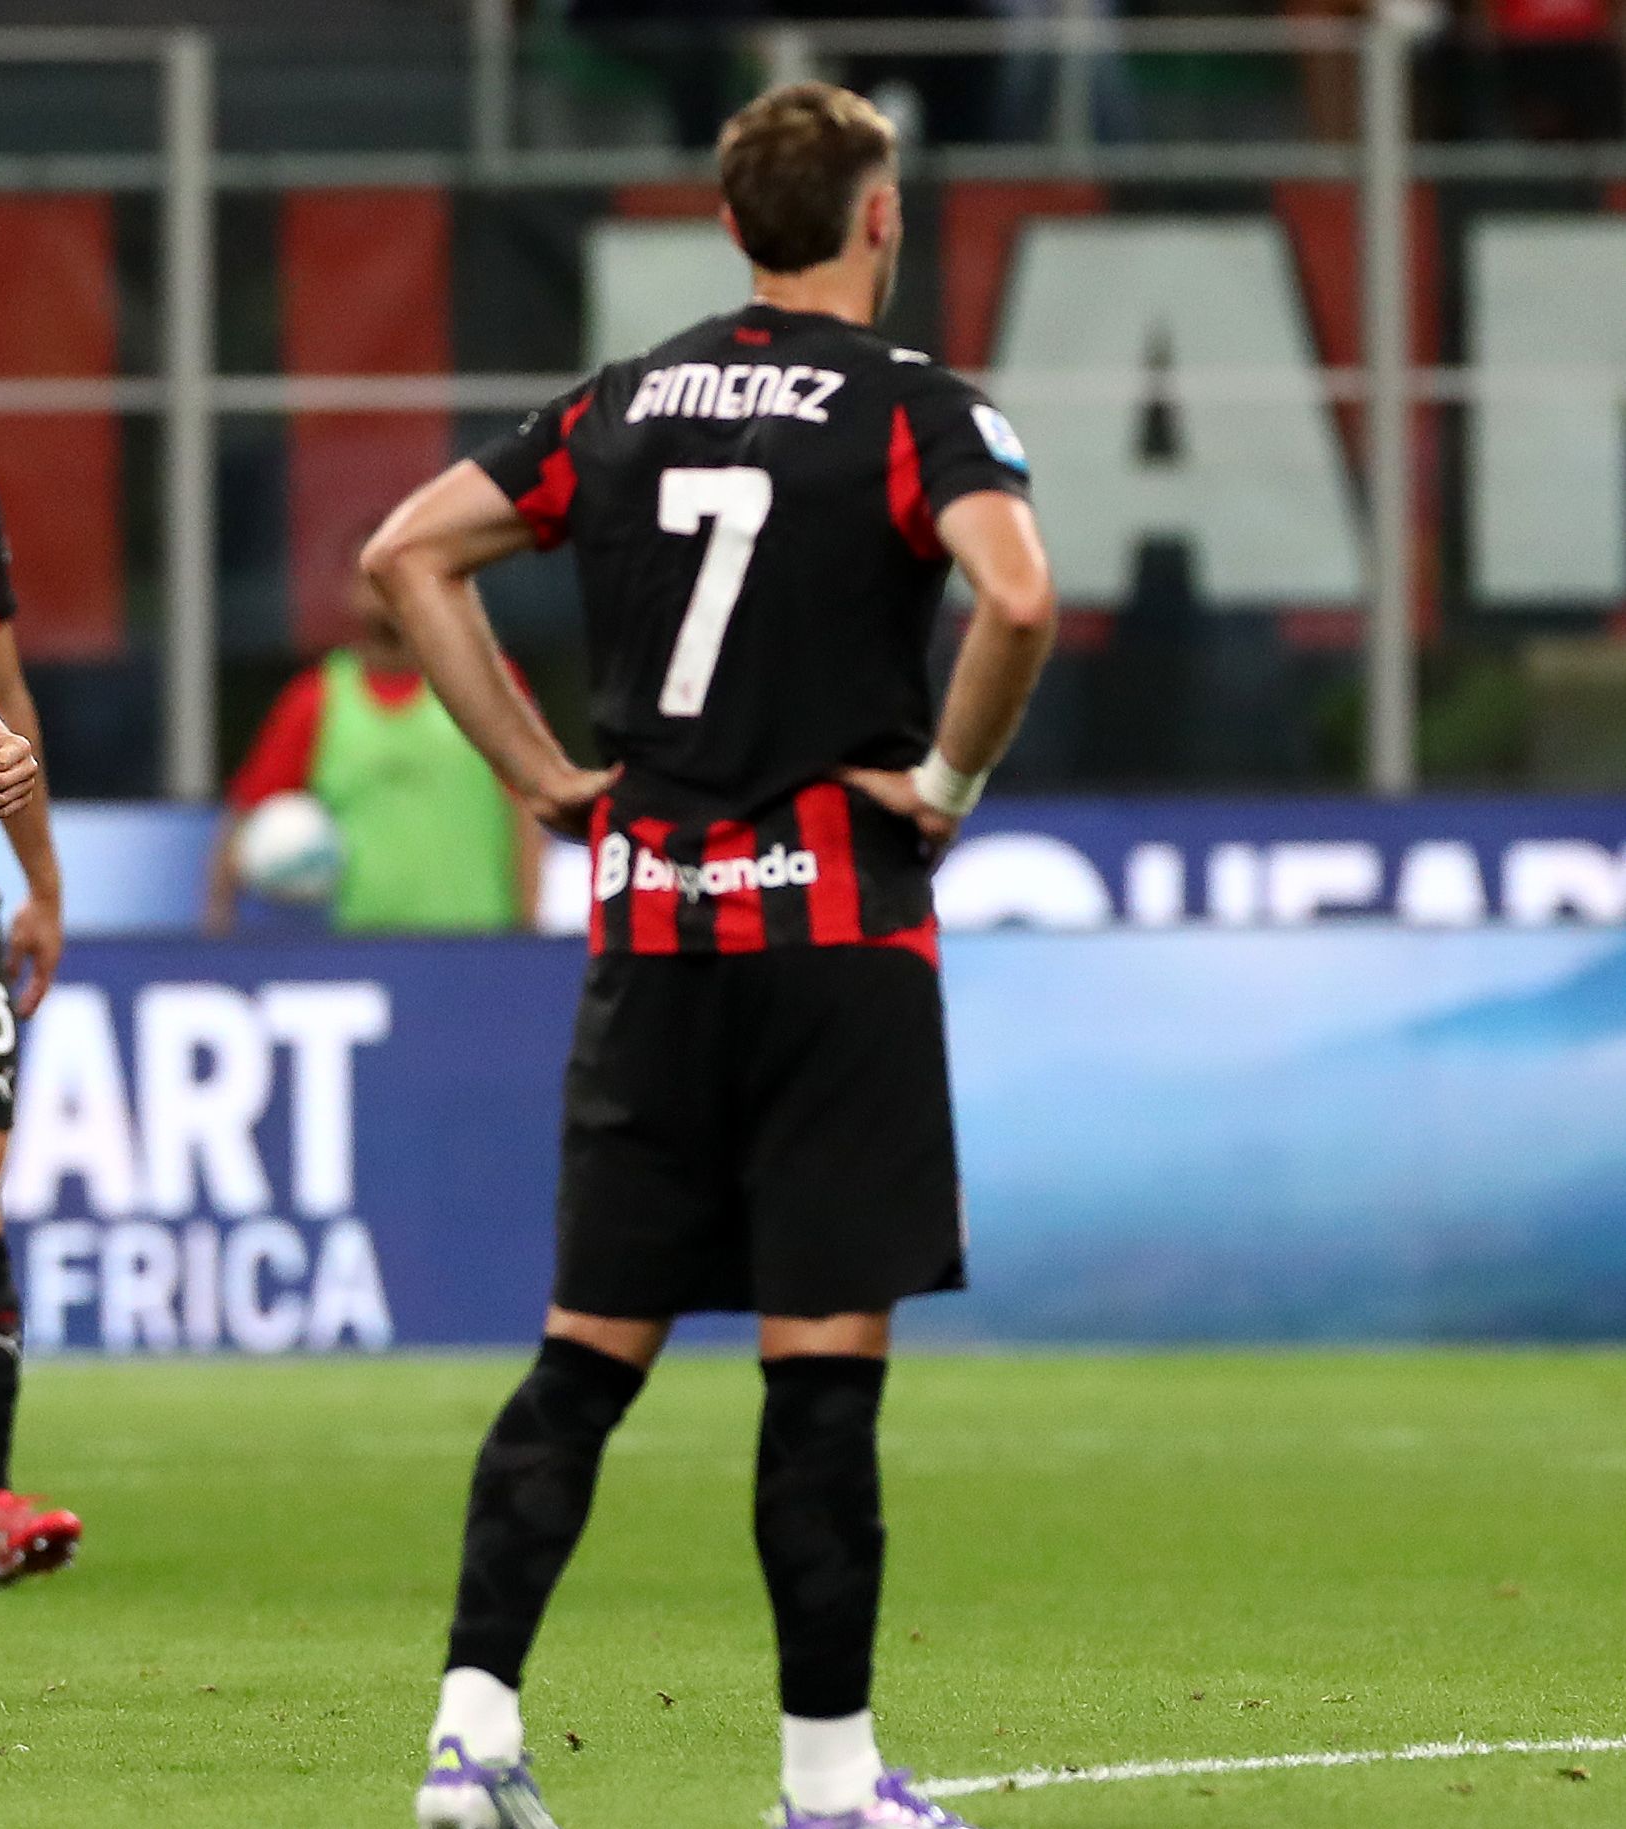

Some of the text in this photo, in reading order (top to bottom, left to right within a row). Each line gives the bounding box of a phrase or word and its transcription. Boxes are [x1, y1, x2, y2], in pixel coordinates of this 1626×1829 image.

[625, 362, 847, 424] GIMENEZ
[659, 466, 772, 717] 7
[632, 842, 818, 904] bipanda
[0, 981, 391, 1222] ART
[22, 1218, 393, 1354] FRICA
